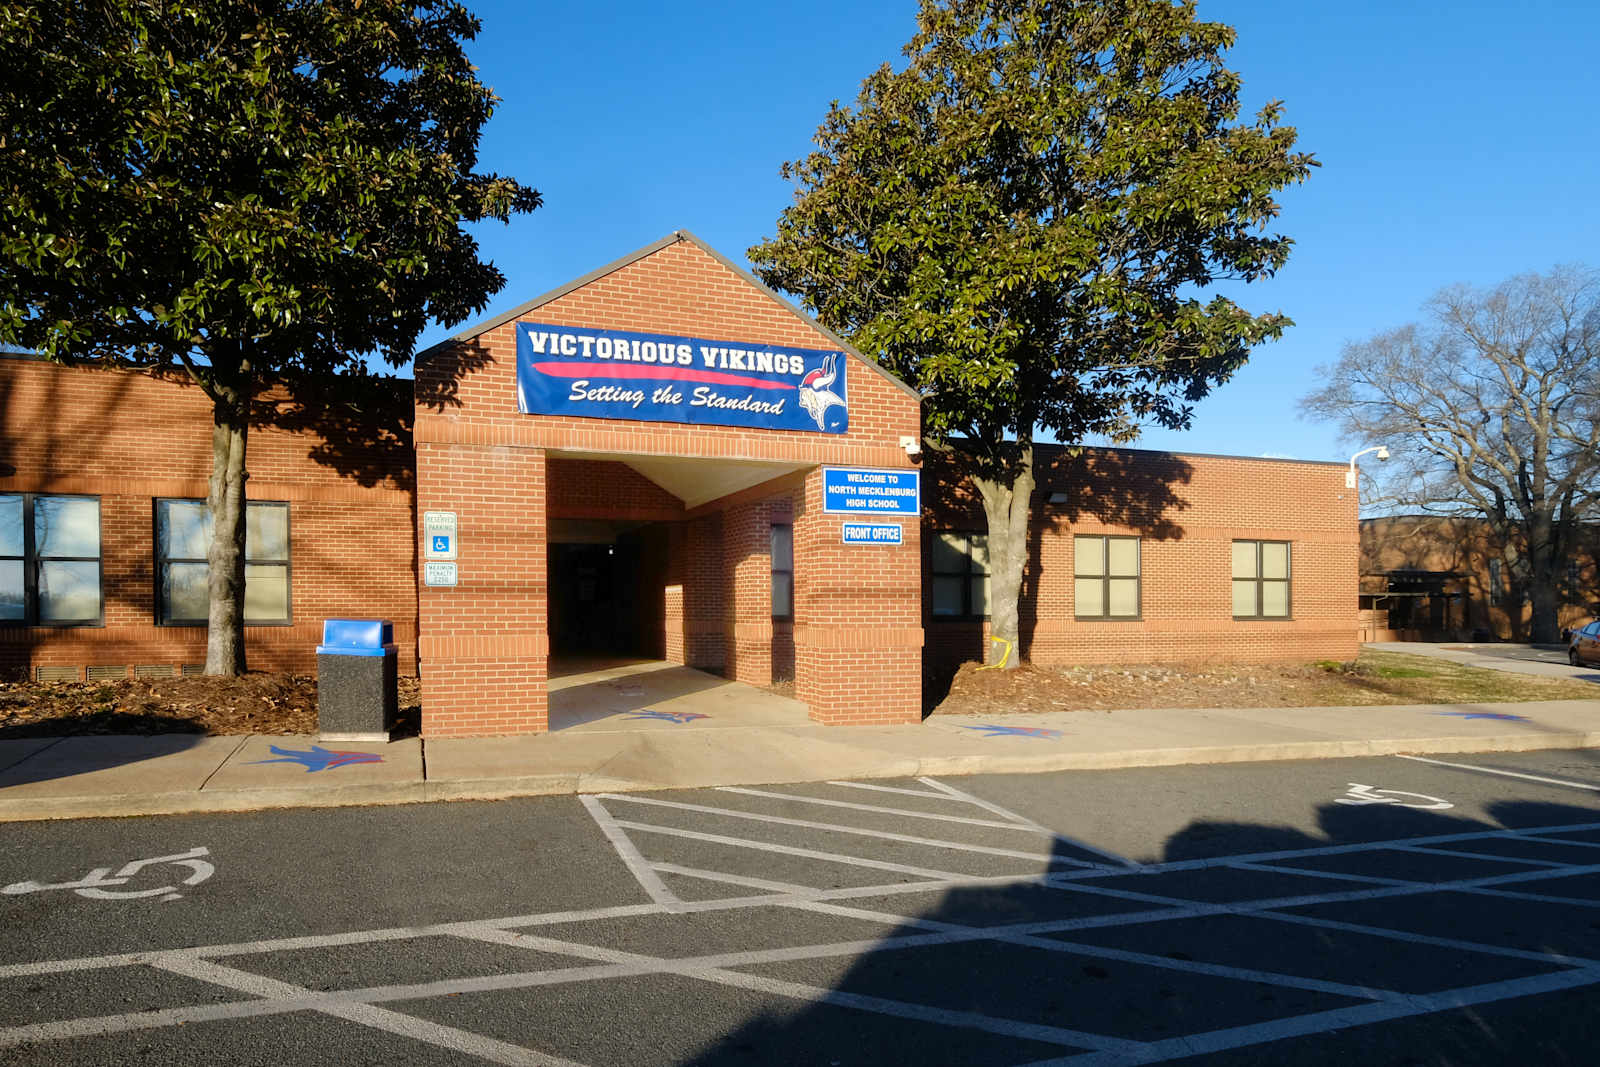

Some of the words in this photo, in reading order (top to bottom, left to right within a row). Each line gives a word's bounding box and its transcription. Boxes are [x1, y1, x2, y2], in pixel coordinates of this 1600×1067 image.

[528, 331, 693, 365] VICTORIOUS
[700, 347, 804, 375] VIKINGS
[568, 380, 645, 408] Setting
[651, 385, 683, 405] the
[690, 386, 785, 415] Standard
[847, 474, 886, 483] WELCOME
[888, 475, 898, 484] TO
[828, 485, 856, 494] NORTH
[858, 486, 916, 496] MECKLENBURG
[846, 499, 866, 507] HIGH
[868, 499, 900, 508] SCHOOL
[845, 527, 871, 539] FRONT
[872, 528, 899, 540] OFFICE
